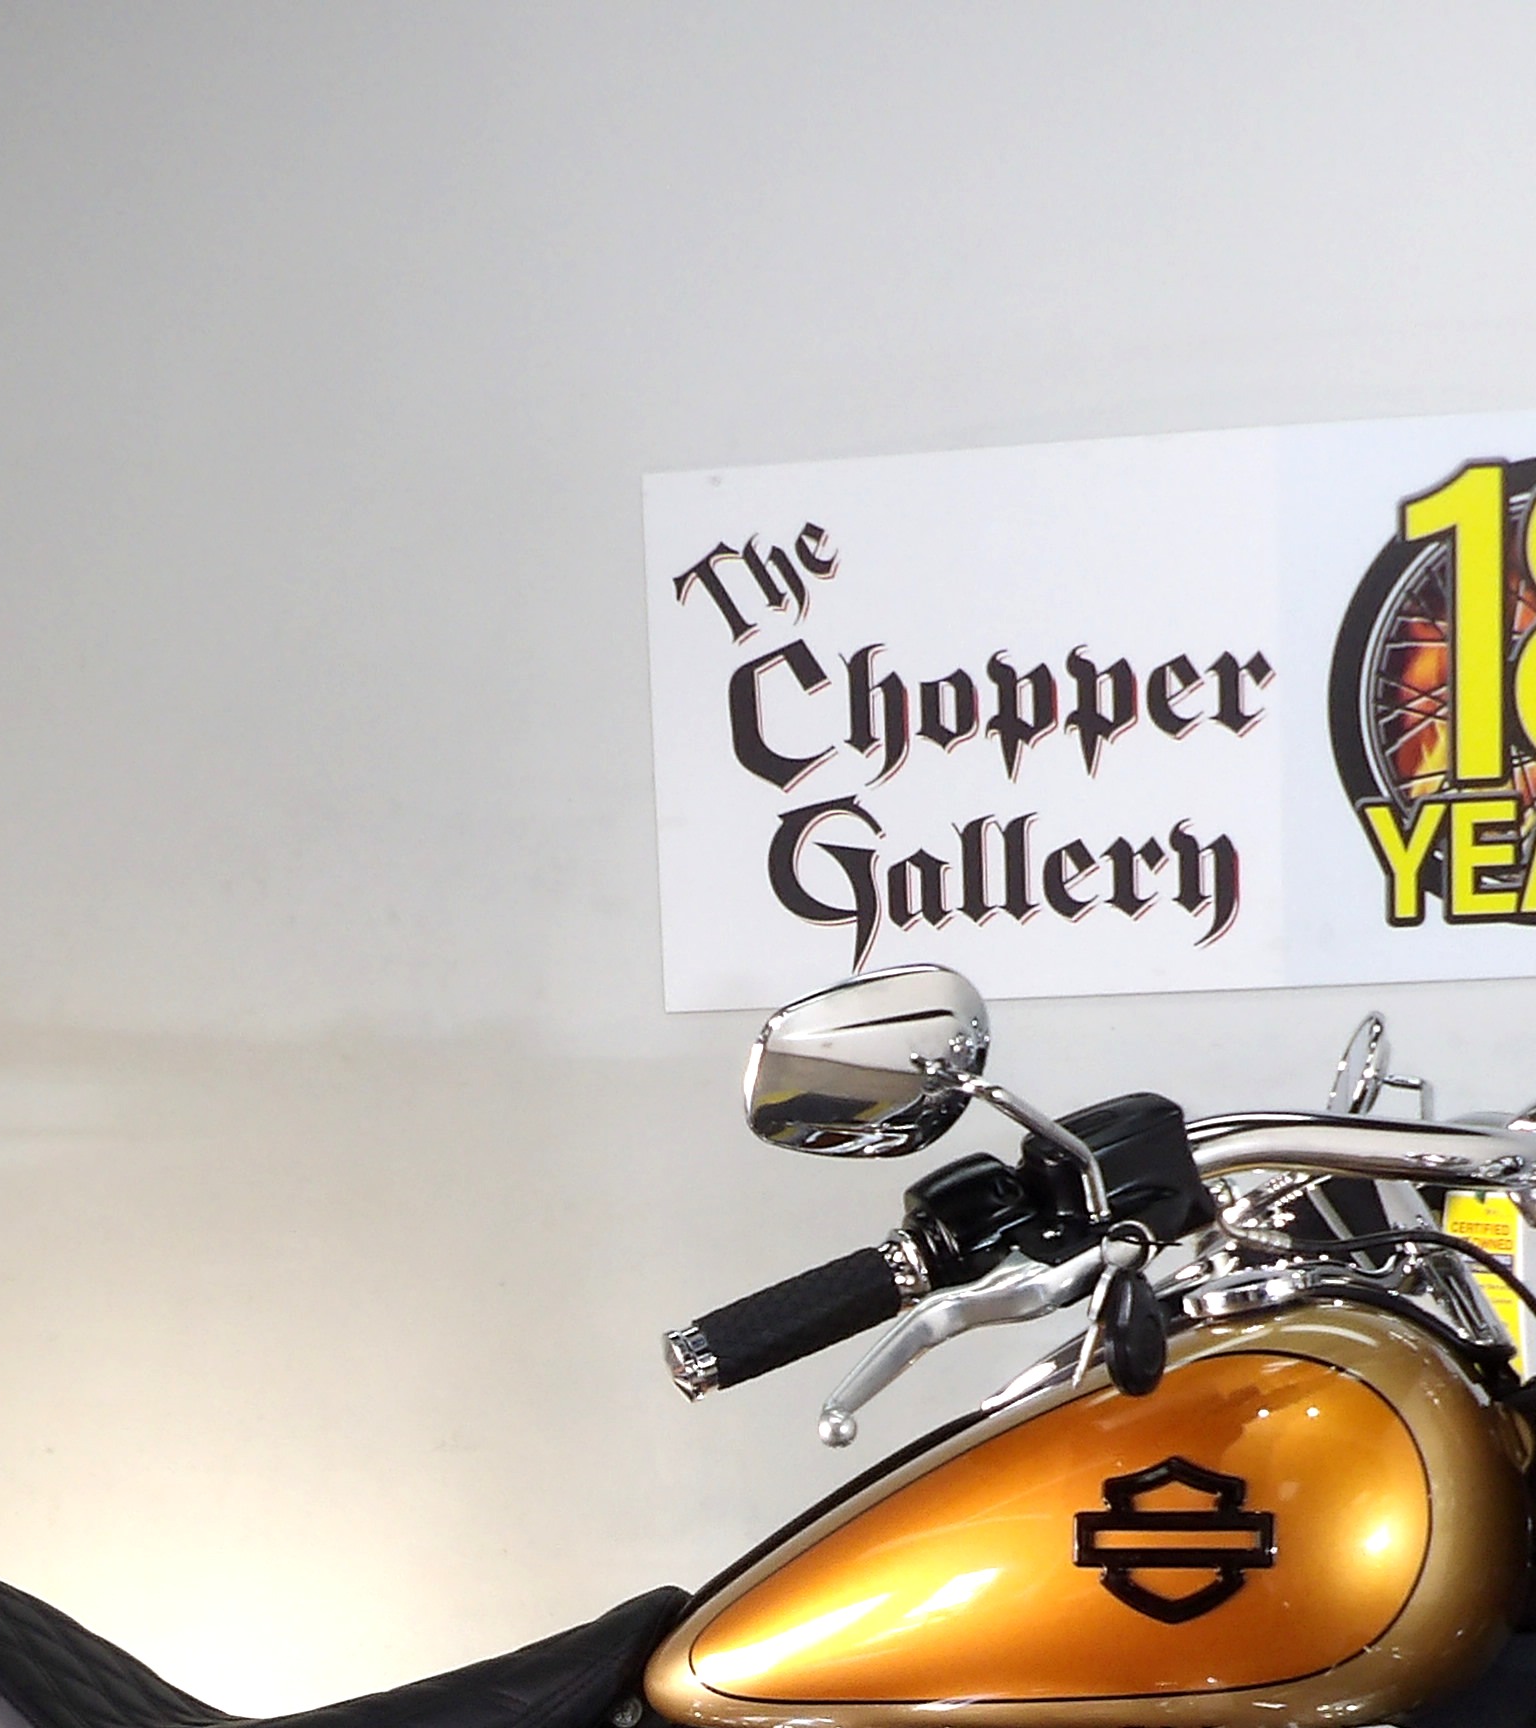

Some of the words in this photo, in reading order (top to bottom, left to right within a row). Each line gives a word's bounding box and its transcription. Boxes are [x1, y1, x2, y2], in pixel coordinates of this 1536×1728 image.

[671, 521, 838, 644] The
[727, 637, 1275, 791] Chopper
[767, 793, 1242, 974] Gallery
[1450, 1221, 1511, 1236] CERTIFIED
